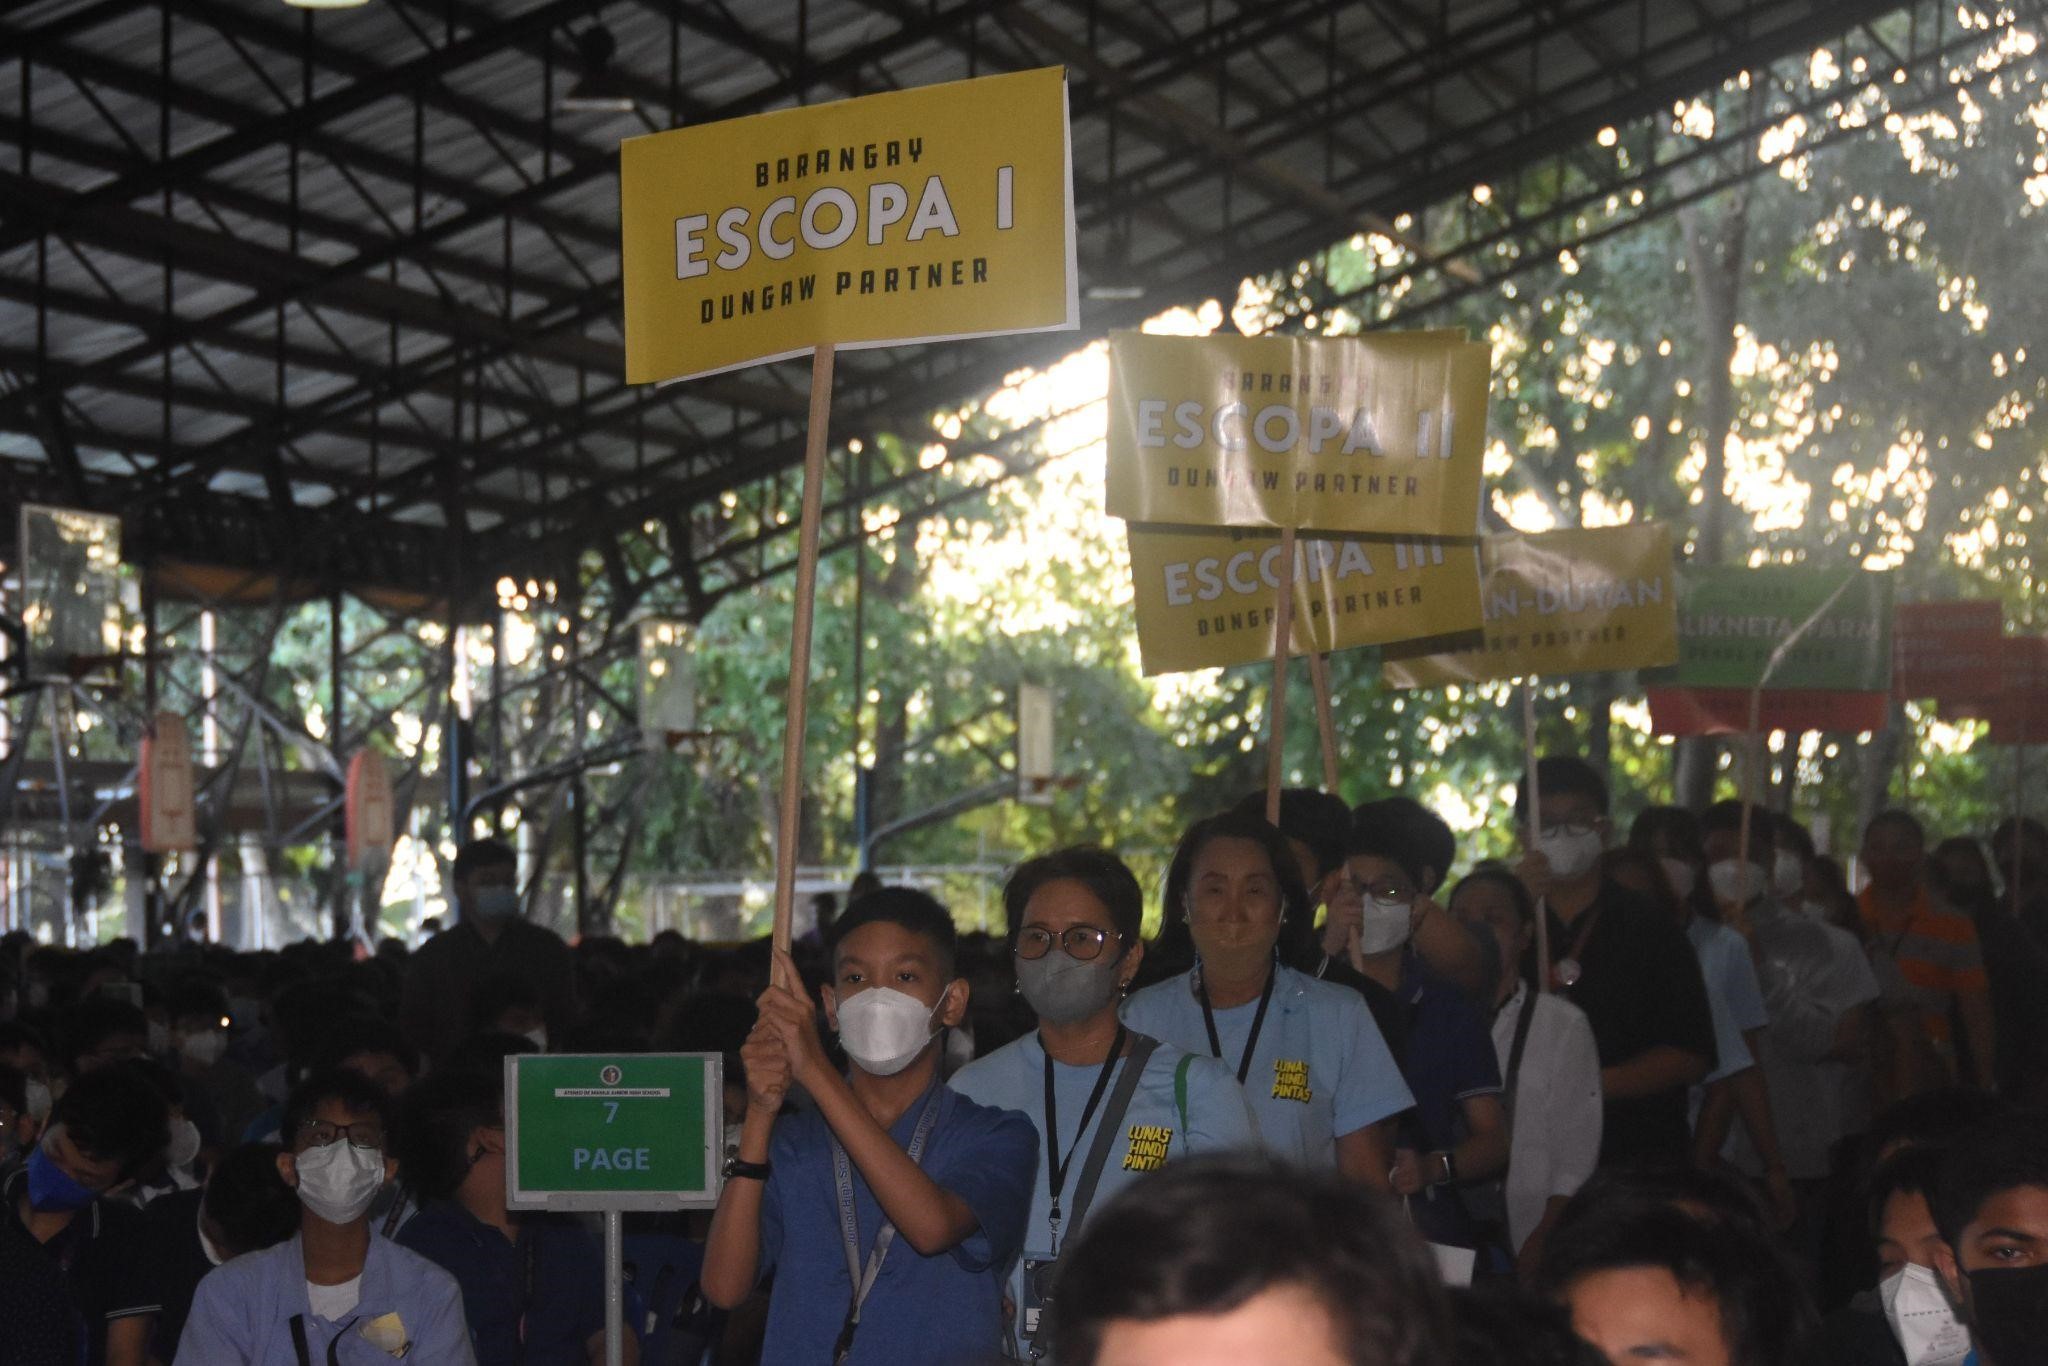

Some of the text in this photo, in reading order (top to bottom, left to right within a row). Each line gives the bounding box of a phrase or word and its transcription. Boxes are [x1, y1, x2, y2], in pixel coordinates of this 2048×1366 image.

[755, 138, 923, 188] BARANGAY
[674, 165, 1014, 281] ESCOPA I
[701, 257, 988, 324] DUNGAW PARTNER
[1222, 371, 1370, 394] BARANG
[1137, 399, 1455, 460] ESCOPA II
[1168, 466, 1418, 496] DUNW PARTNER
[1273, 1058, 1309, 1074] LUNAS
[1275, 1071, 1308, 1088] HINDI
[1271, 1084, 1312, 1104] PINTAS
[603, 1101, 619, 1124] 7
[1127, 1125, 1173, 1145] LUNAS
[573, 1148, 650, 1170] PAGE
[1129, 1138, 1168, 1158] HINDI
[1122, 1154, 1167, 1172] PINTA
